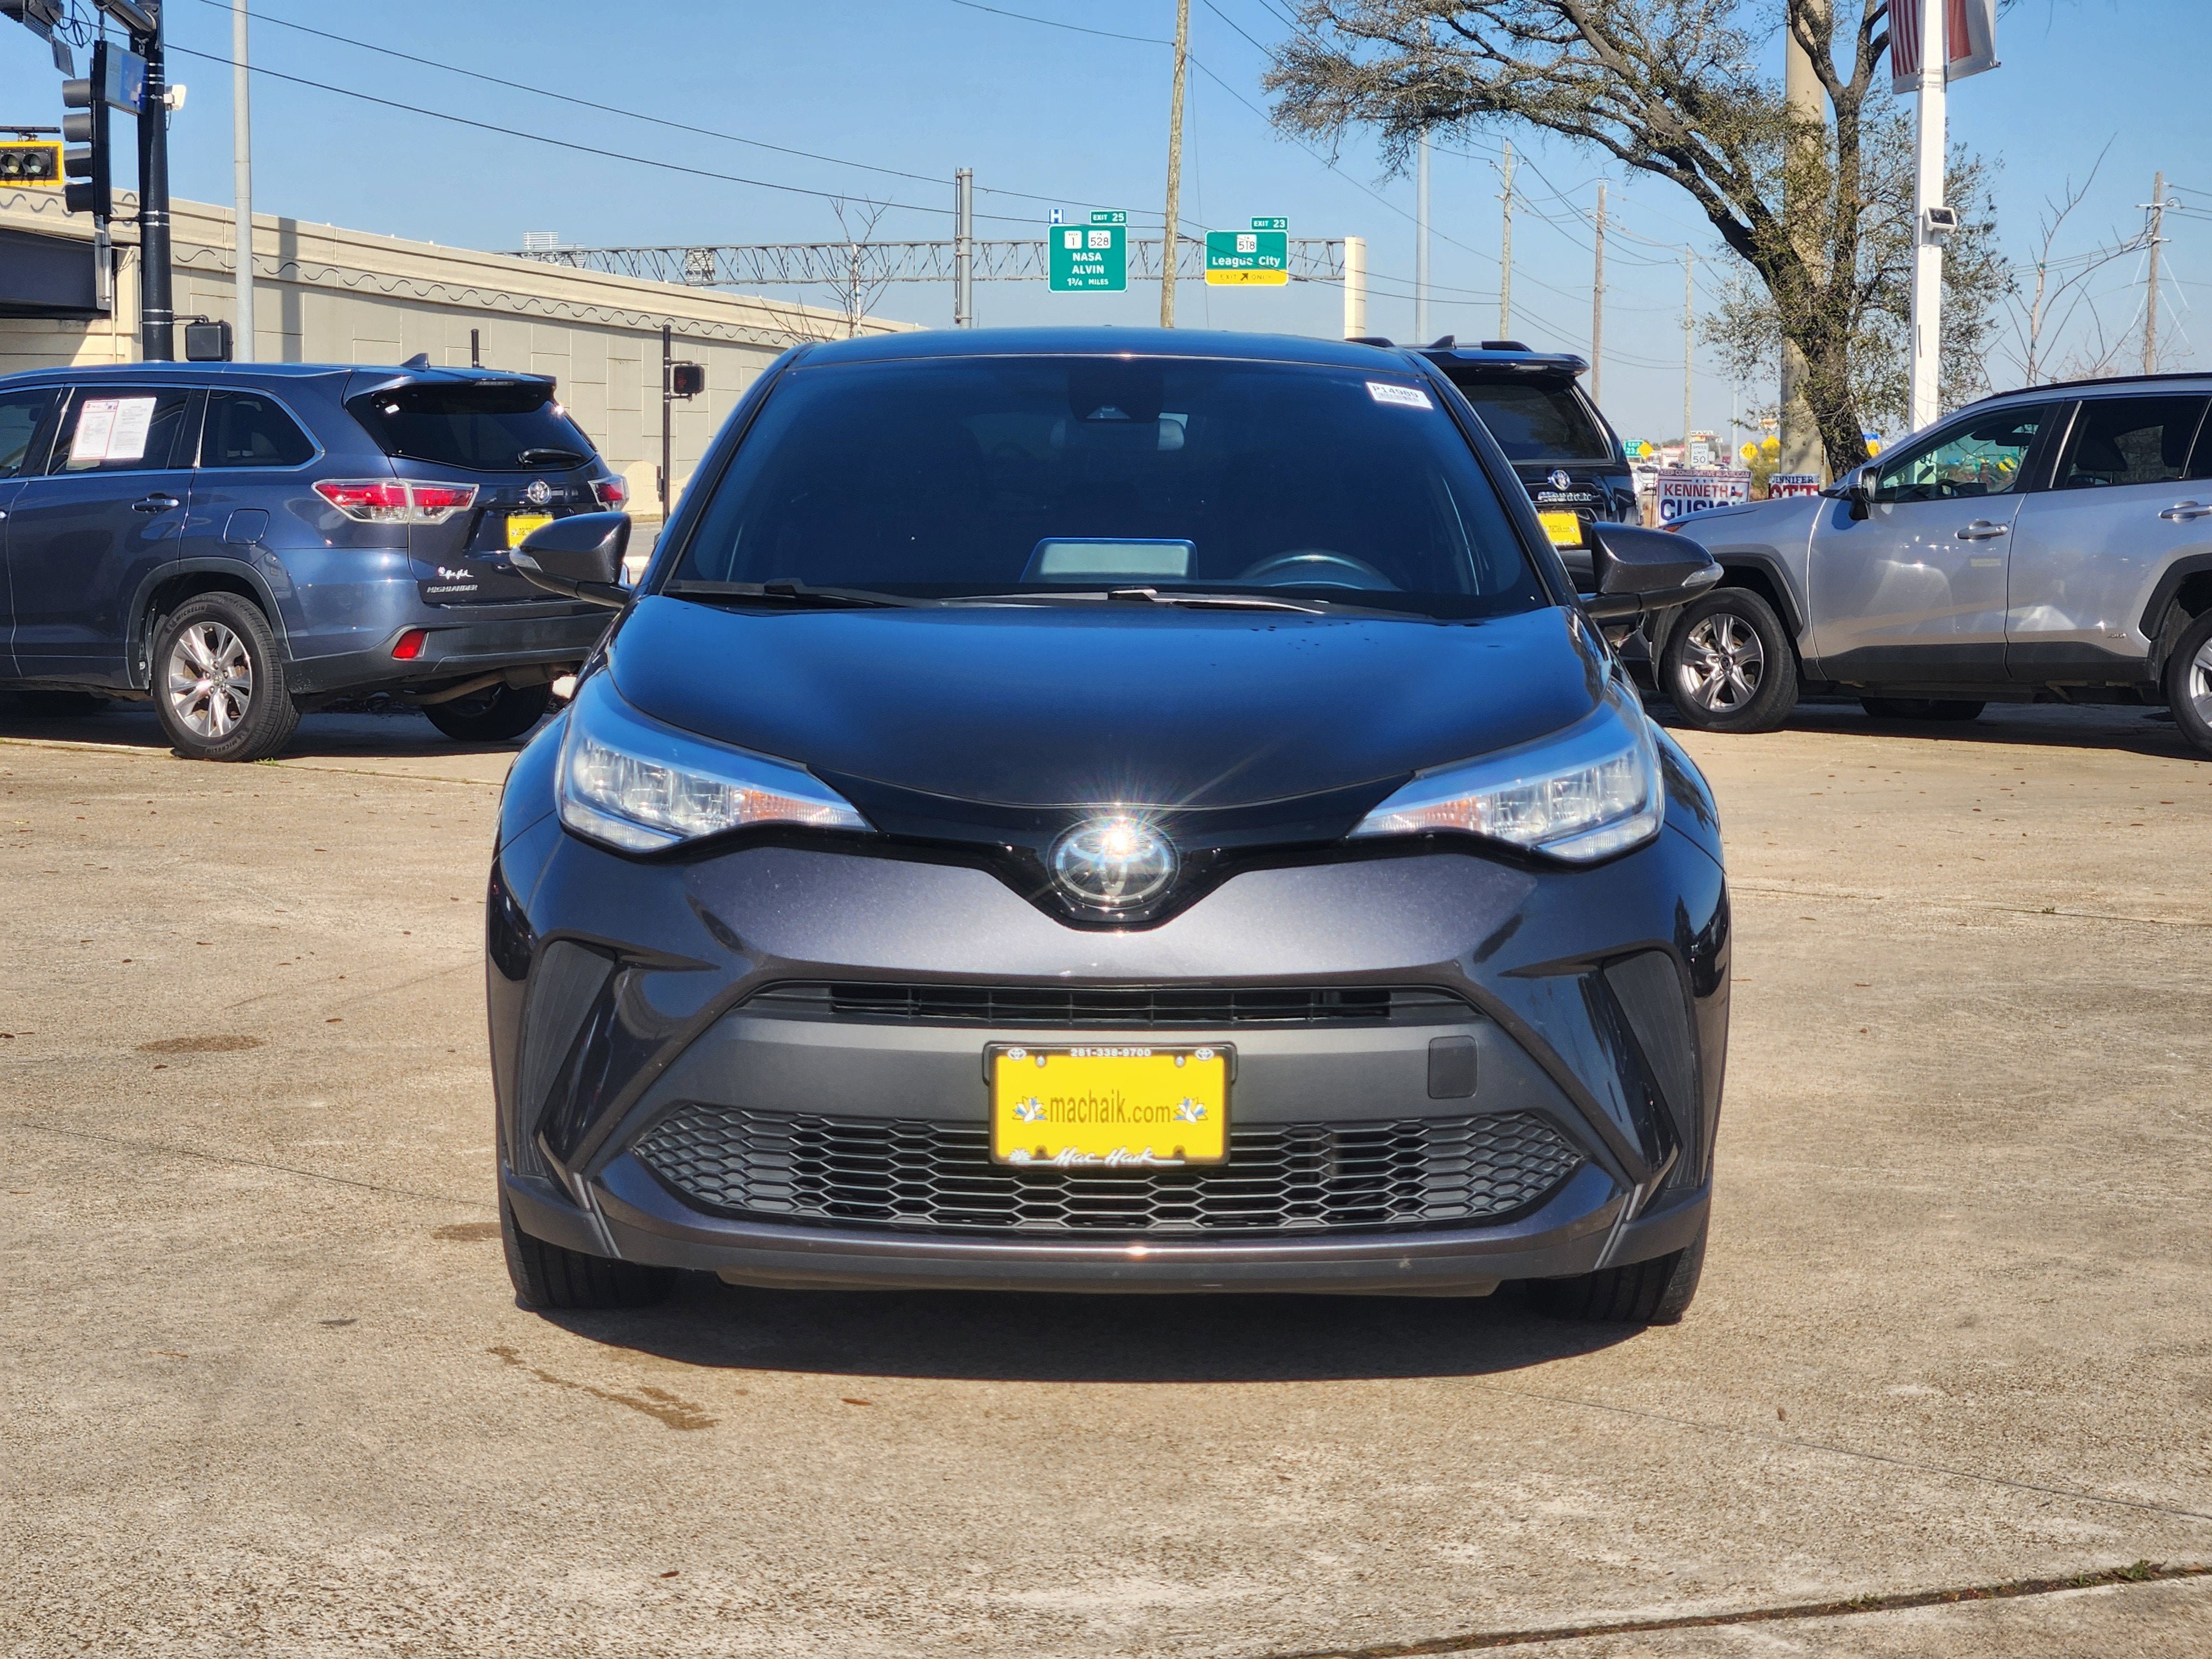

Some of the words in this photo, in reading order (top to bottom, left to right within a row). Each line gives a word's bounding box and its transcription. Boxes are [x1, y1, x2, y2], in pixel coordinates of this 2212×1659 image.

[1050, 209, 1062, 223] H
[1112, 212, 1124, 222] 25
[1273, 219, 1286, 228] 23
[1091, 237, 1109, 246] 528
[1238, 241, 1255, 250] 518
[1072, 252, 1102, 262] NASA
[1212, 256, 1254, 268] League
[1259, 255, 1281, 267] City
[1072, 265, 1104, 274] ALVIN
[1665, 483, 1728, 498] KENNETH
[427, 585, 478, 593] HIGHLANDER
[176, 606, 205, 621] MICHELIN
[1050, 1089, 1171, 1123] machaik.com
[1052, 1146, 1103, 1167] Mac
[1105, 1146, 1155, 1167] Haik
